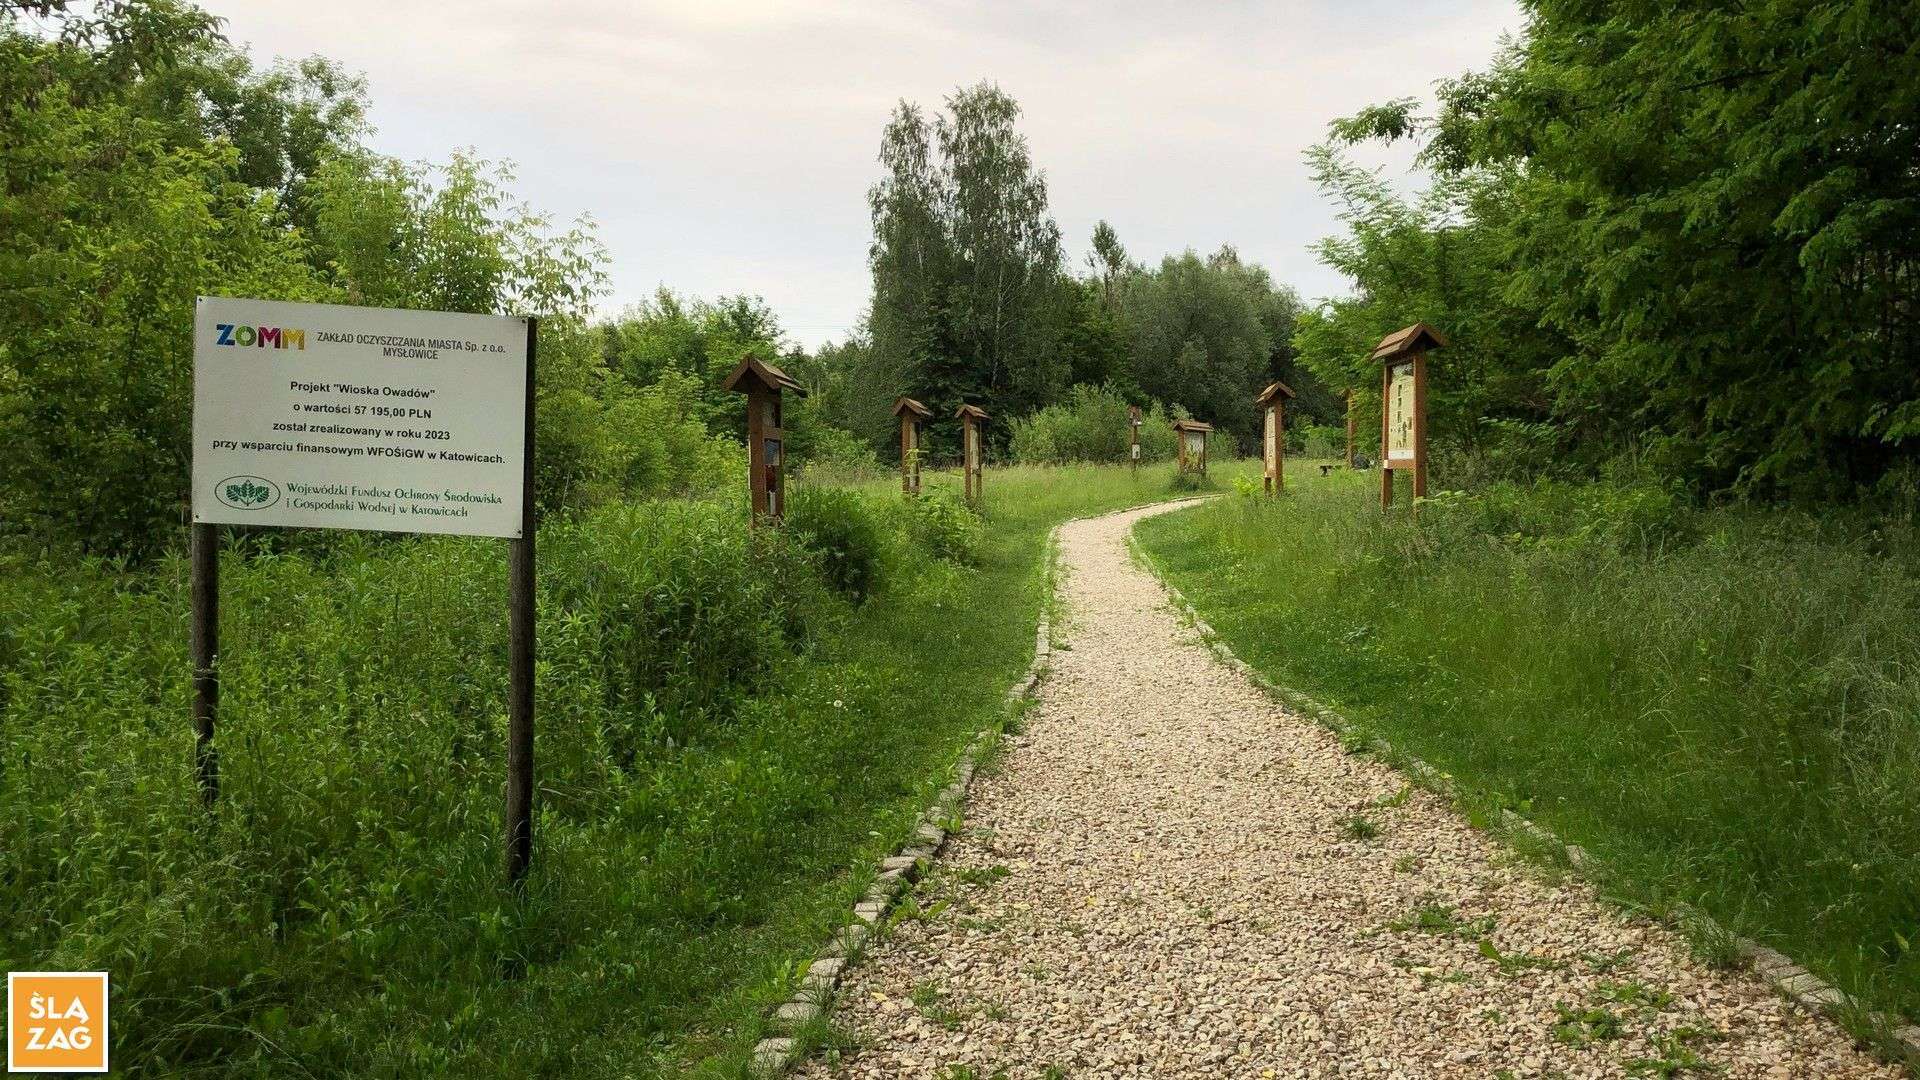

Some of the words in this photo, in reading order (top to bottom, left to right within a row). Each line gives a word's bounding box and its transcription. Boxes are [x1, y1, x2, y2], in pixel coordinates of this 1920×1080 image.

[216, 324, 305, 350] ZOMM
[317, 332, 354, 344] ZAKŁAD
[356, 334, 426, 347] OCZYSZCZANIA
[428, 338, 463, 350] MIASTA
[465, 340, 479, 352] Sp.
[482, 344, 487, 352] z
[489, 345, 506, 353] o.o.
[383, 347, 438, 359] MYSŁOWICE
[290, 381, 331, 394] Projekt
[333, 384, 379, 396] "Wioska
[382, 386, 435, 398] Owadów"
[303, 403, 351, 414] wartości
[354, 405, 366, 415] 57
[370, 406, 406, 419] 195,00
[409, 408, 431, 419] PLN
[272, 422, 307, 432] został
[310, 423, 381, 438] zrealizowany
[384, 429, 394, 437] w
[397, 428, 422, 438] roku
[425, 429, 450, 440] 2023
[212, 438, 238, 451] przy
[241, 441, 293, 452] wsparciu
[296, 442, 364, 457] finansowym
[367, 446, 425, 459] WFOŚiGW
[427, 451, 437, 460] w
[440, 451, 506, 464] Katowicach.
